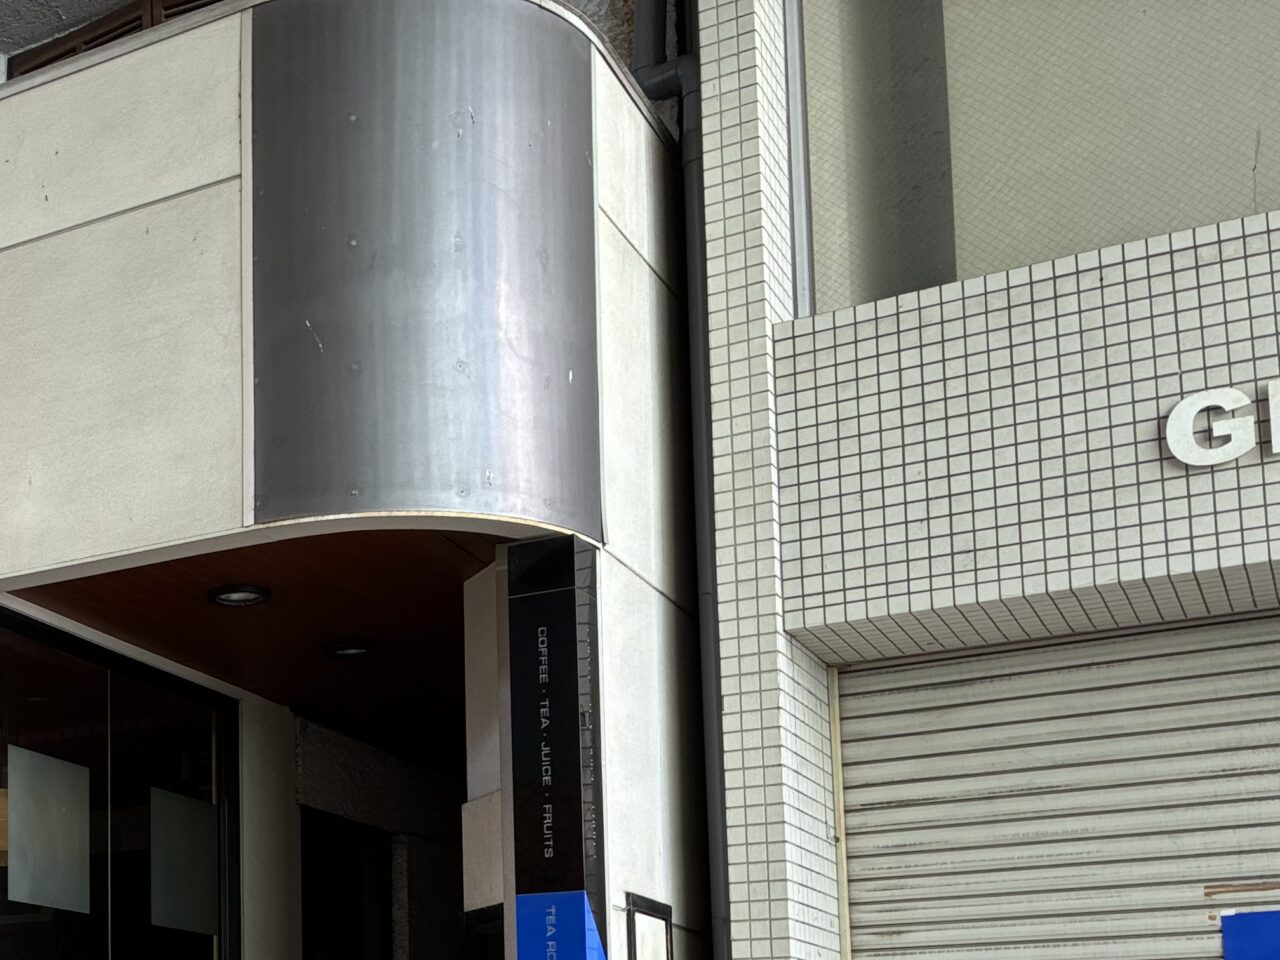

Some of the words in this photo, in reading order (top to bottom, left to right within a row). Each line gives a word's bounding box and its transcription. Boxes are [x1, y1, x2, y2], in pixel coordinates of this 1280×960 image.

[1165, 380, 1280, 466] G
[537, 626, 549, 684] COFFEE
[539, 698, 550, 729] TEA
[541, 740, 552, 786] JUICE
[542, 804, 554, 858] FRUITS
[545, 905, 557, 937] TEA
